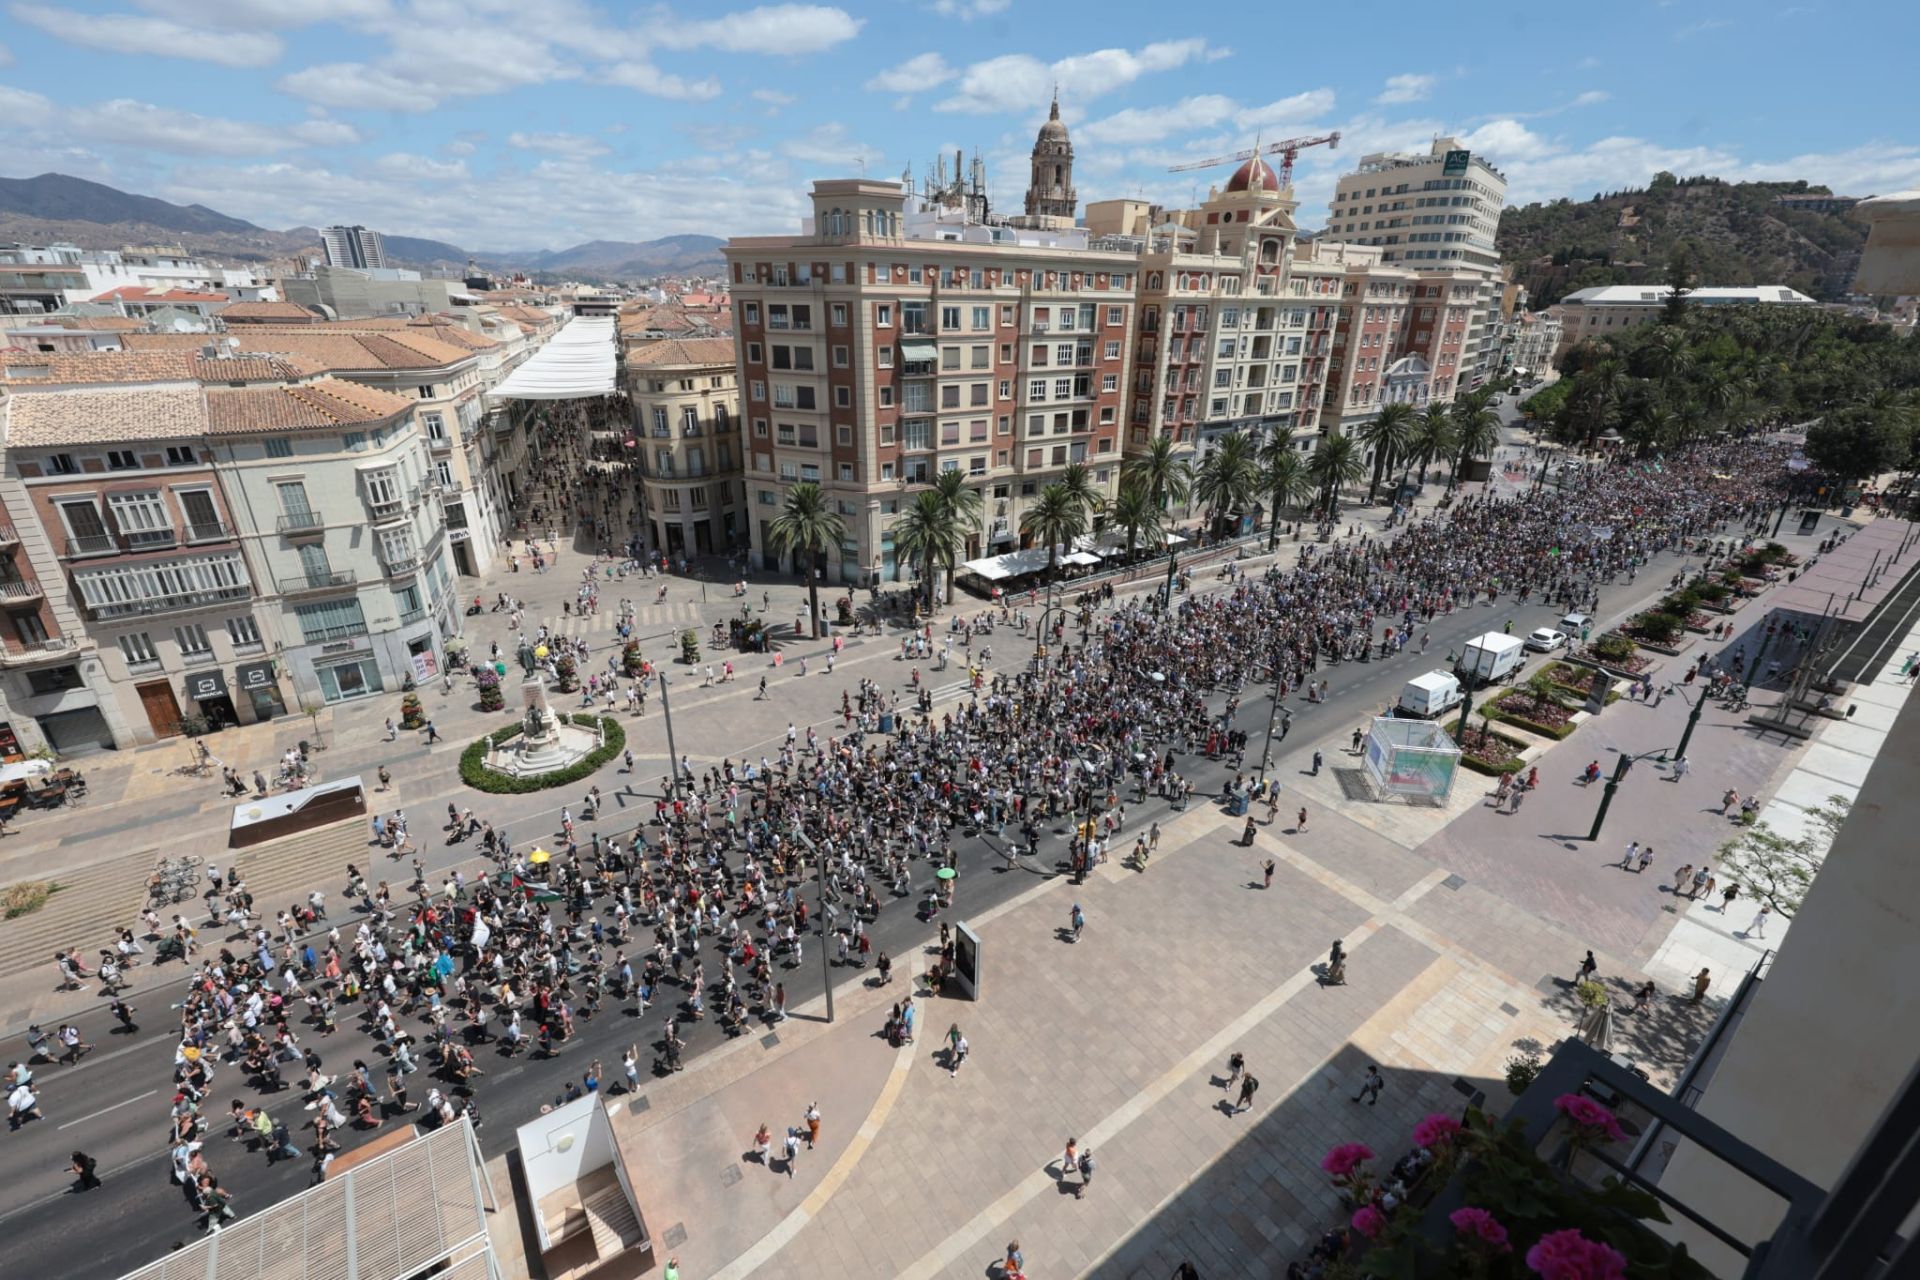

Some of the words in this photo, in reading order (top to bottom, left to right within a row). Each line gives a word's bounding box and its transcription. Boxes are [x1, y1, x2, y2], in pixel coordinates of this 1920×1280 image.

[1449, 153, 1468, 163] AC
[449, 530, 470, 540] BBVA
[244, 681, 273, 690] FARMACIA
[193, 690, 224, 700] FARMACIA
